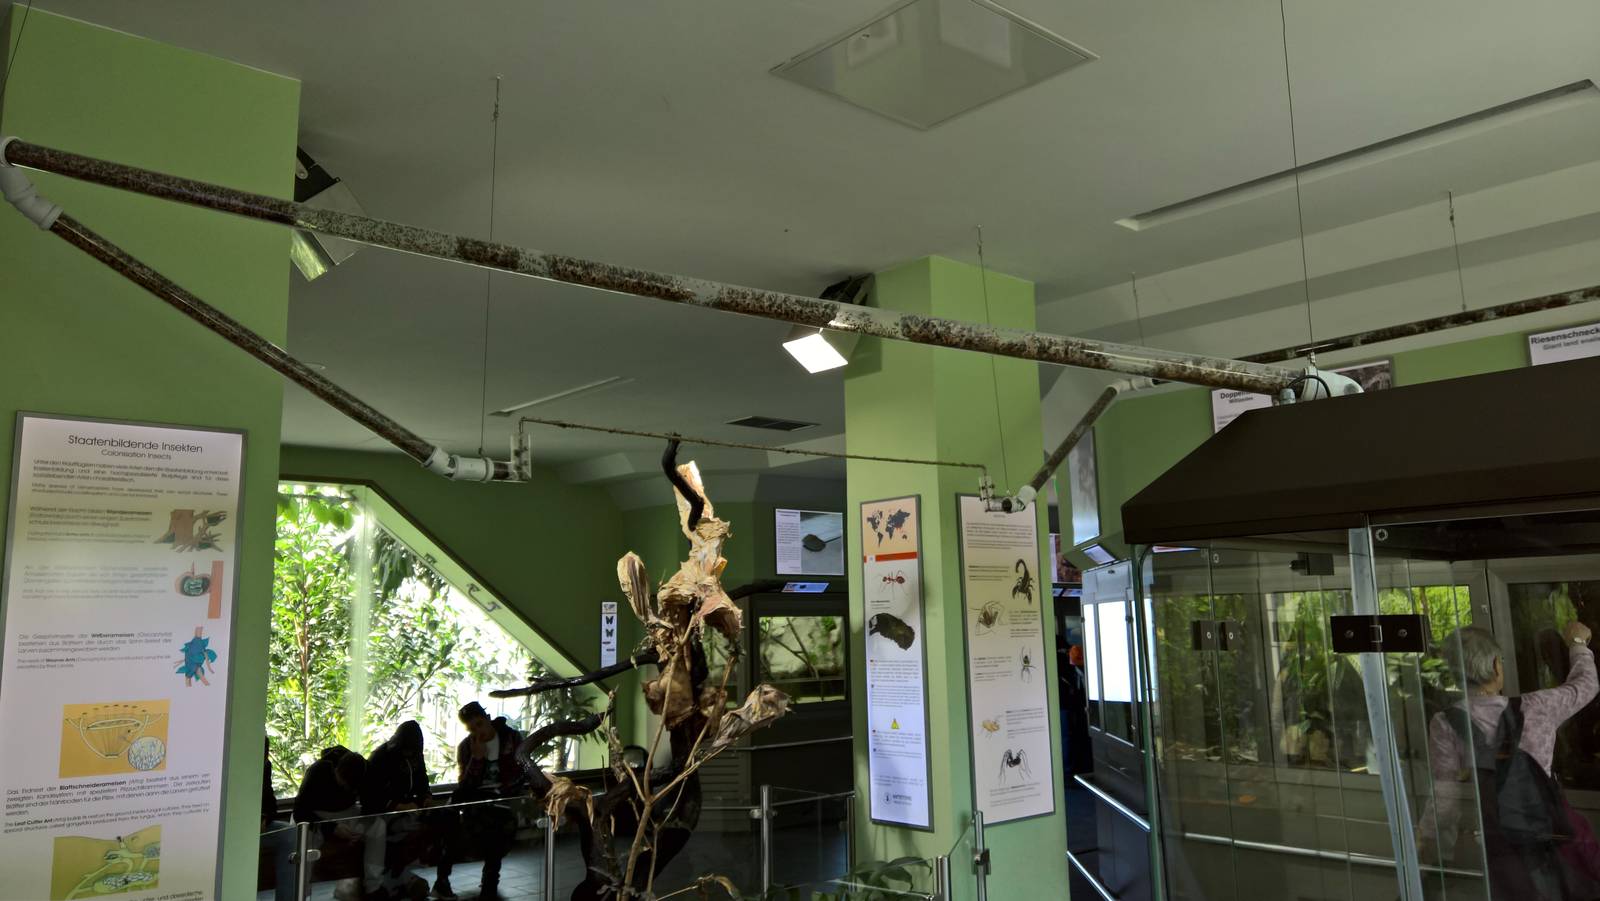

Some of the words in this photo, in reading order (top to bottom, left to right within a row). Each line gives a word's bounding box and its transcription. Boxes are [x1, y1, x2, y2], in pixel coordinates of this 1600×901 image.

[68, 434, 159, 450] Staatenbildende
[162, 441, 203, 454] Insekten
[147, 451, 172, 460] Insects
[60, 781, 126, 790] Blattschneiderameisen
